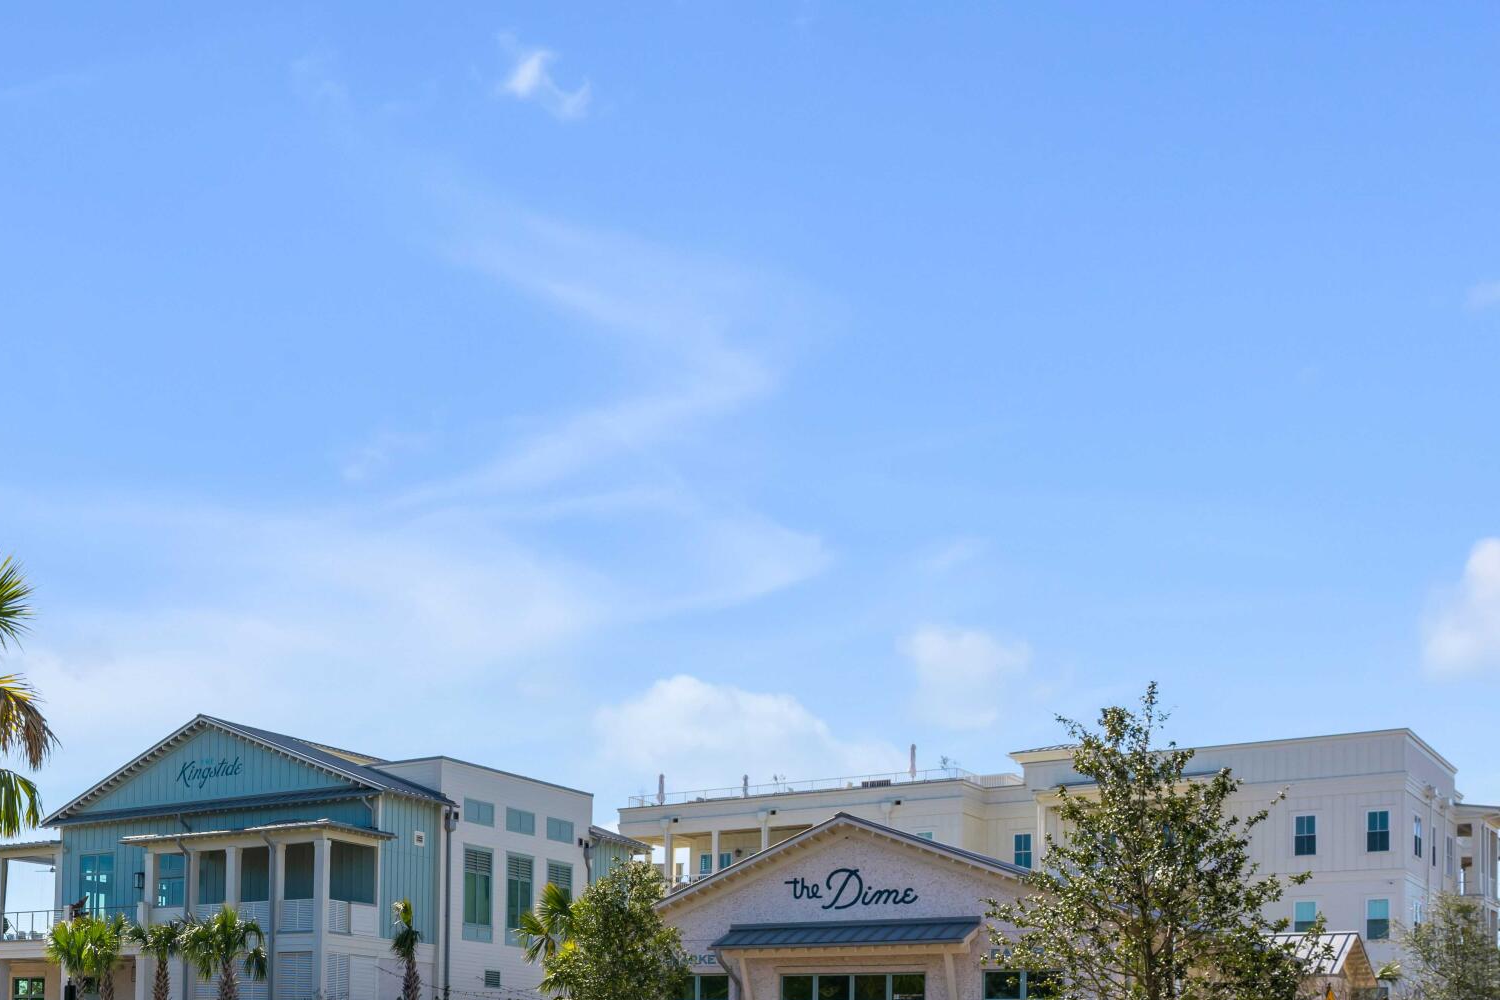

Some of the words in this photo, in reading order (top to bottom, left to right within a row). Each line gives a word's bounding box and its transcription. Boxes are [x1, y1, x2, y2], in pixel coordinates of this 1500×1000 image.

[175, 756, 243, 789] Kingstide
[784, 877, 823, 900] the
[821, 868, 919, 910] Dime
